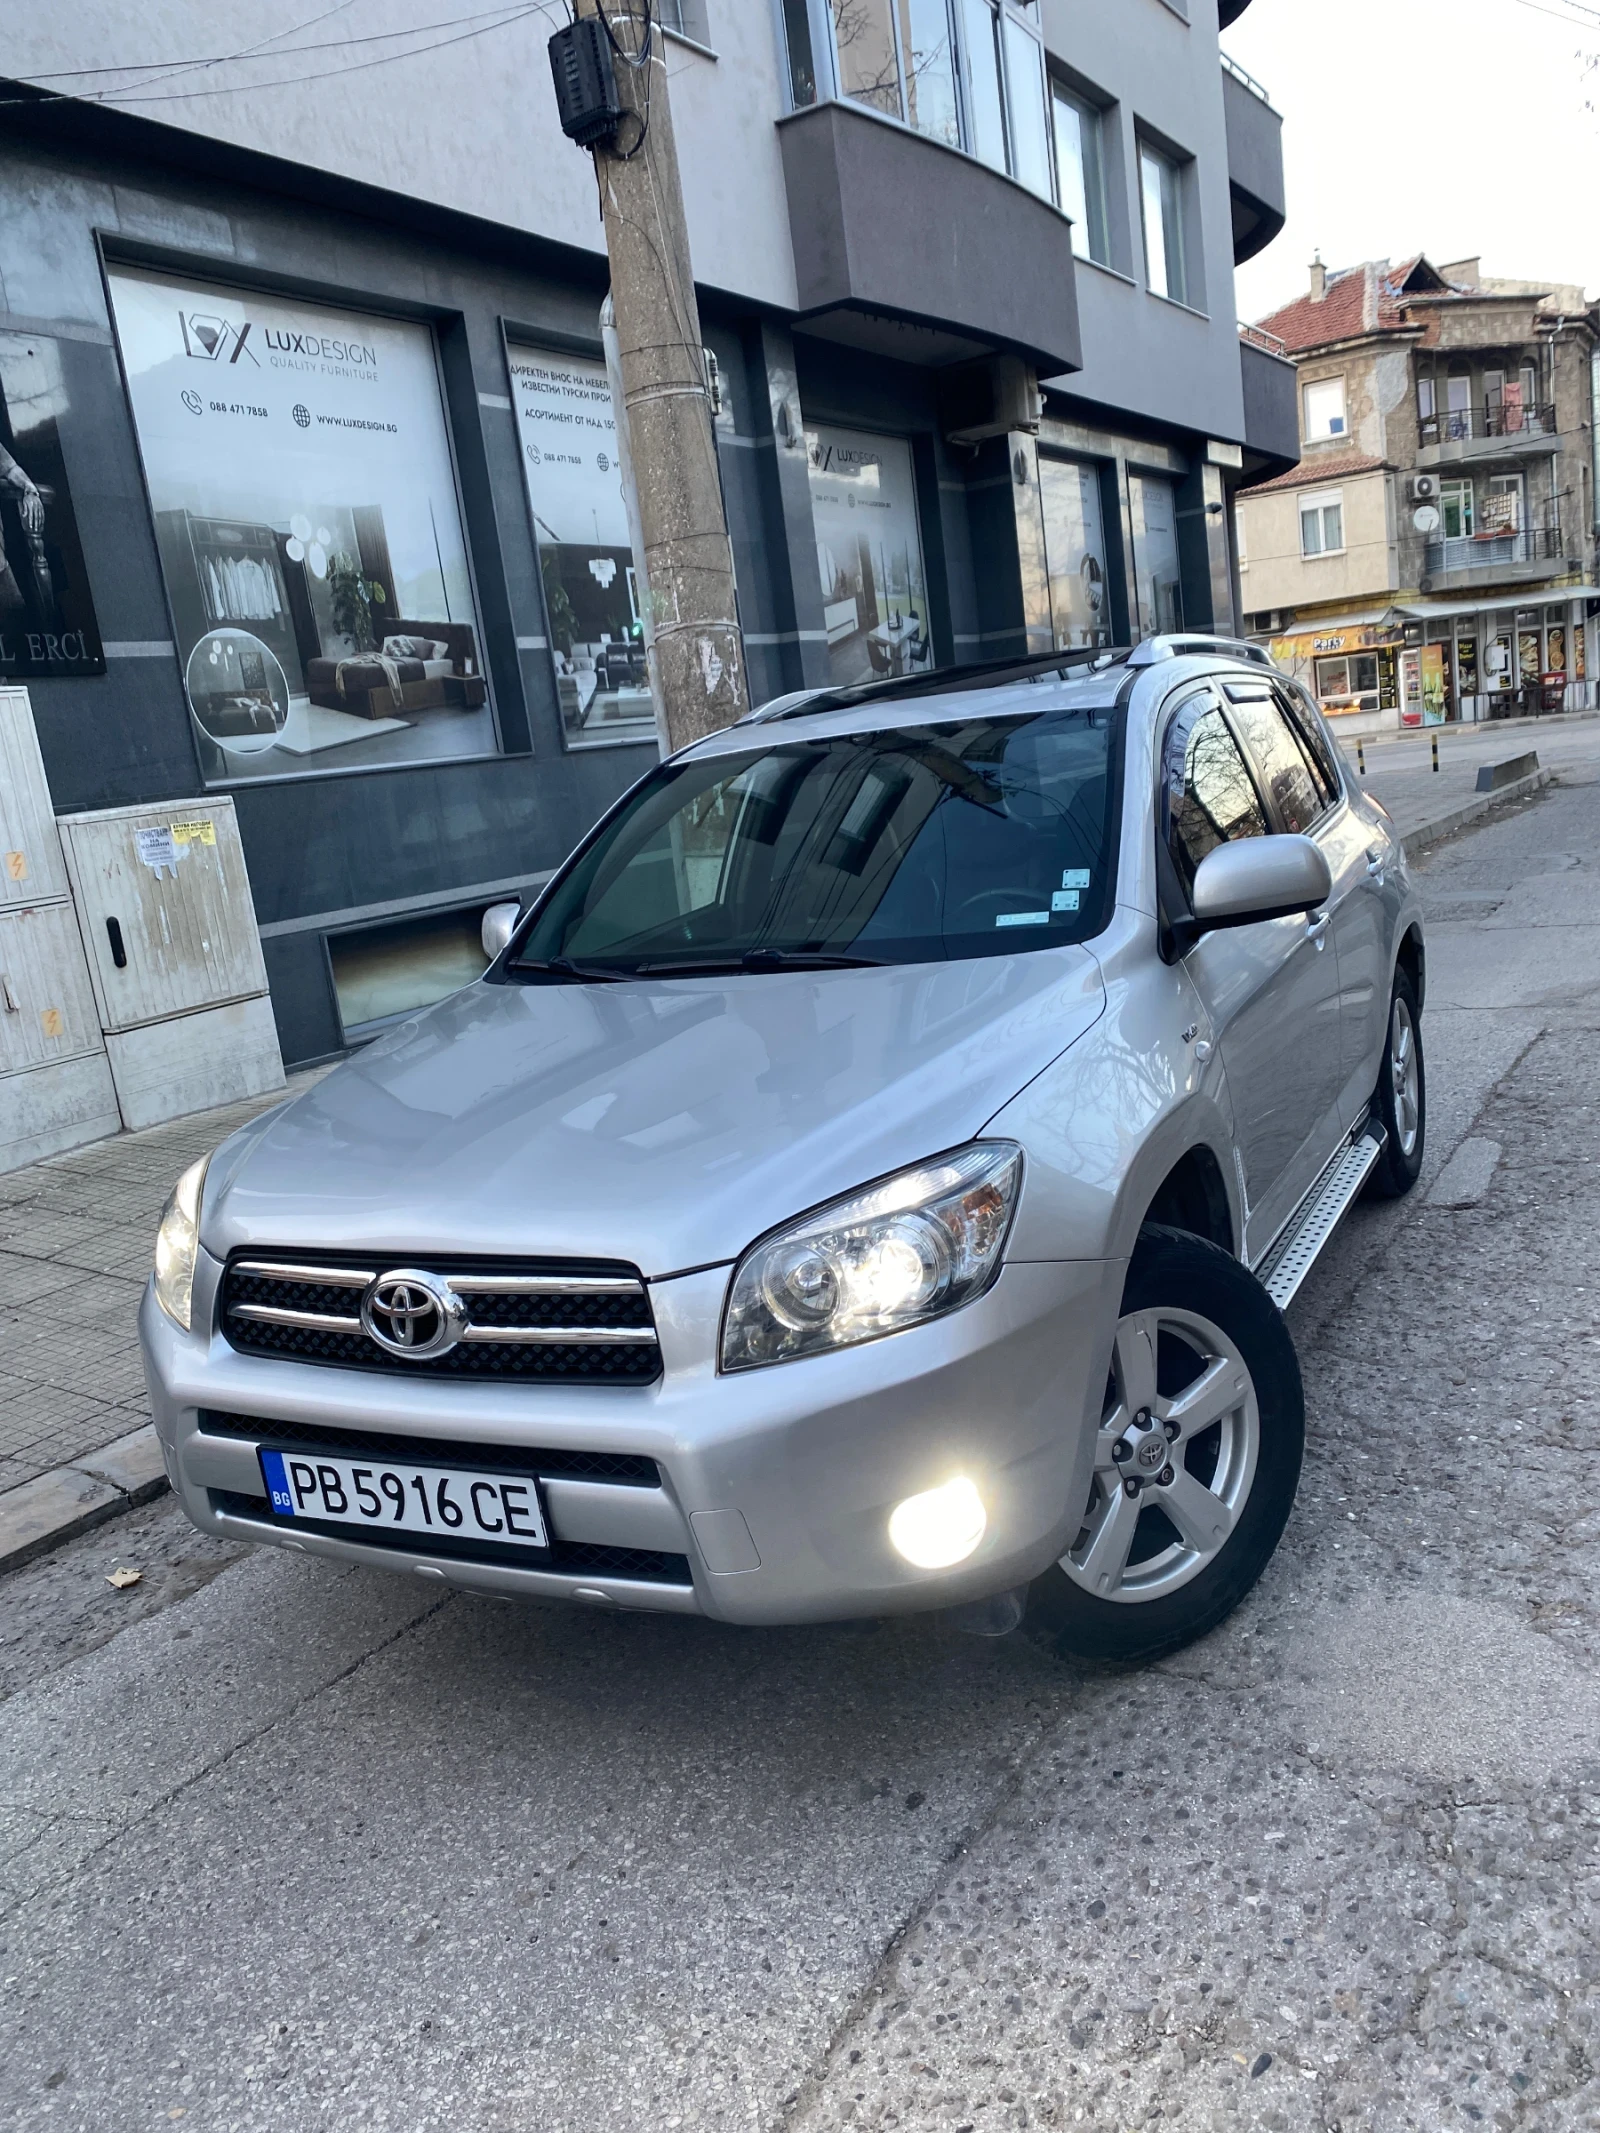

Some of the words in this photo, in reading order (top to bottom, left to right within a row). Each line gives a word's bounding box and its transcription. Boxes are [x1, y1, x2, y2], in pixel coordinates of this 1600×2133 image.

[264, 328, 377, 366] LUXDESIGN
[270, 356, 316, 372] QUALITY
[321, 361, 379, 382] FURNITURE
[510, 365, 549, 379] ДИРЕКТЕН
[550, 371, 572, 383] ВНОС
[573, 375, 584, 385] НА
[521, 380, 560, 395] ИЗВЕСТНИ
[562, 386, 590, 400] ТУРСКИ
[210, 401, 227, 413] 088
[316, 414, 398, 433] WWW.LUXDESIGN.BG
[525, 408, 573, 424] АСОРТИМЕНТ
[574, 416, 585, 425] ОТ
[586, 418, 602, 429] НАД
[1313, 635, 1346, 649] Party
[273, 1491, 291, 1506] BG
